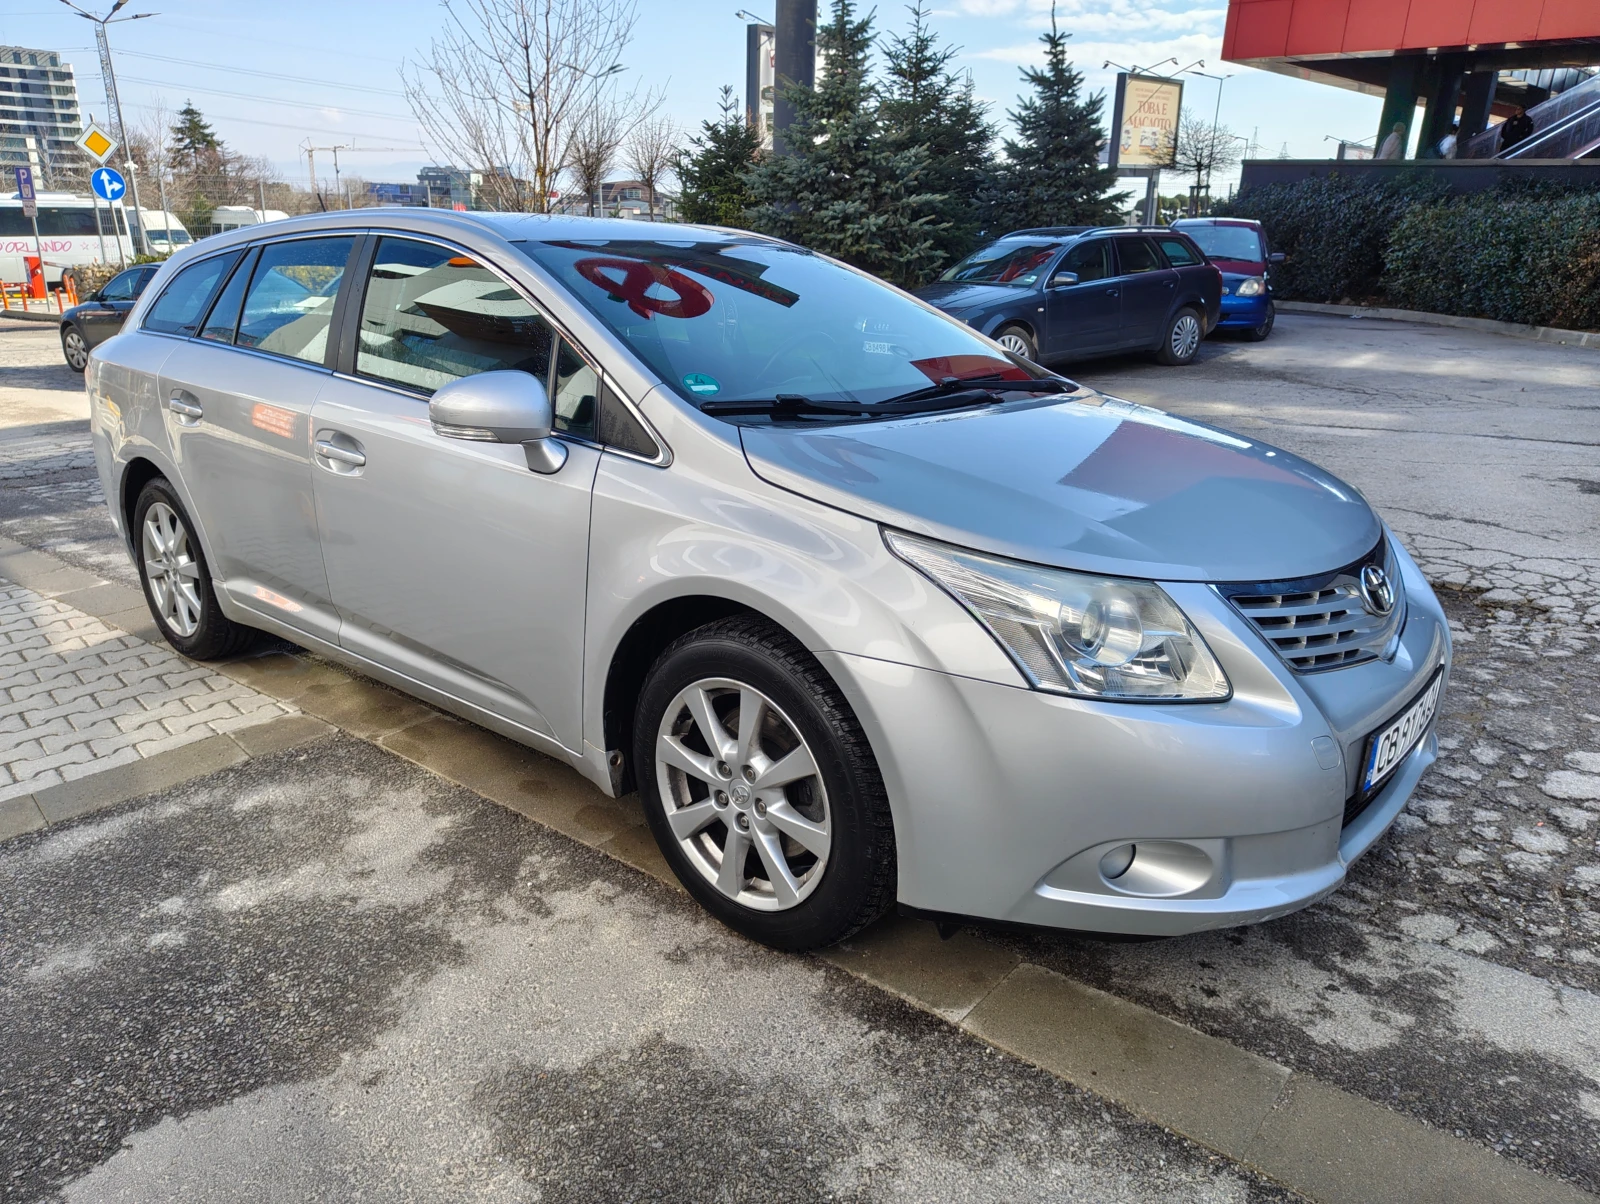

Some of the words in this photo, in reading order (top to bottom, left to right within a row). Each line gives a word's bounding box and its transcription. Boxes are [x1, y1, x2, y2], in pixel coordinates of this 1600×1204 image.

[19, 168, 27, 184] P
[695, 375, 705, 385] 4
[1377, 726, 1399, 773] CB
